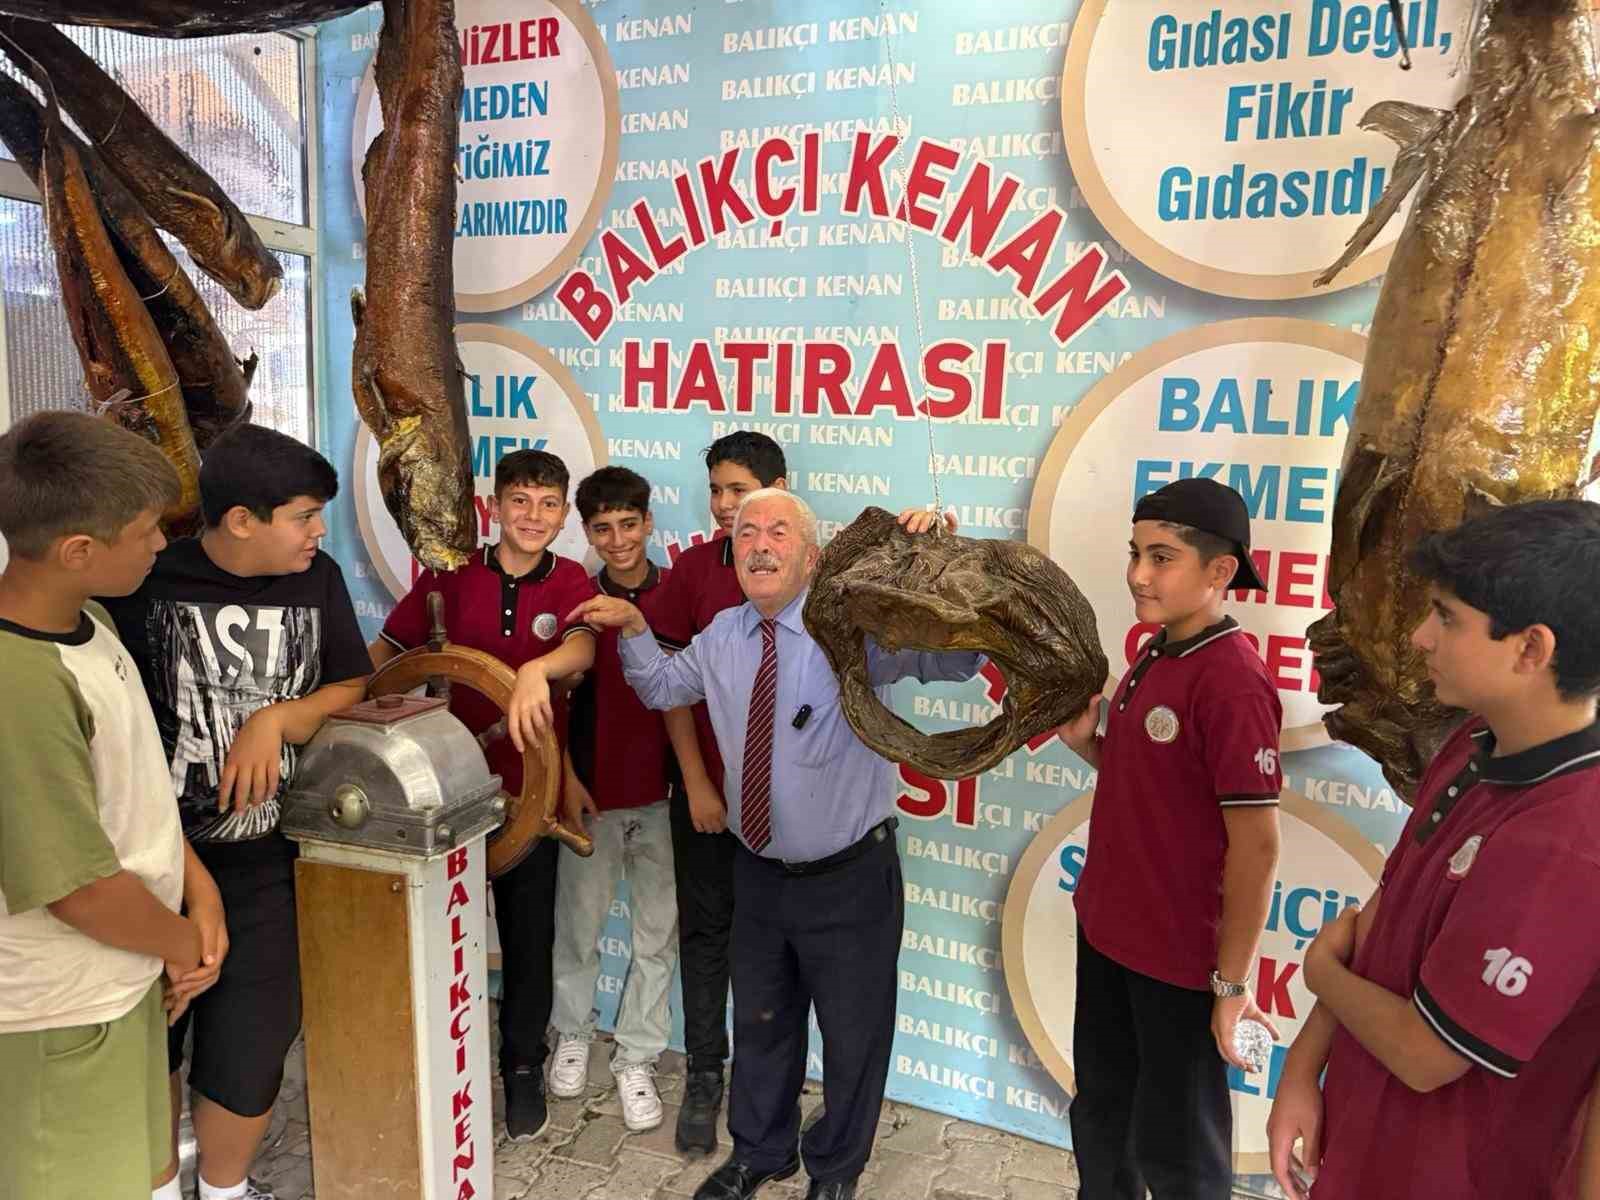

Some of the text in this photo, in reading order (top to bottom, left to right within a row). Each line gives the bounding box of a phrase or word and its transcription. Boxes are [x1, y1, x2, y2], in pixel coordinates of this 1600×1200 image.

[616, 14, 691, 42] KENAN
[723, 11, 918, 52] BALIKÇI KENAN
[955, 23, 1069, 55] BALIKÇI
[1148, 10, 1290, 71] Gıdası
[615, 64, 690, 89] KENAN
[722, 63, 915, 101] BALIKÇI KENAN
[1225, 79, 1353, 142] Fikir
[1158, 157, 1386, 221] Gıdasıdı
[454, 198, 568, 237] ARIMIZDIR
[555, 131, 1128, 343] BALIKÇI KENAN
[716, 273, 902, 302] BALIKÇI KENAN
[471, 374, 537, 419] LIK
[622, 340, 1008, 420] HATIRASI
[1159, 378, 1360, 436] BALIK
[608, 439, 680, 460] KENAN
[809, 424, 893, 447] KENAN
[808, 472, 890, 496] KENAN
[1254, 747, 1276, 775] 16
[907, 836, 1008, 879] BALIKÇI
[900, 970, 1000, 1016] BALIKÇI
[1481, 947, 1534, 996] 16
[897, 1013, 998, 1058] BALIKÇI
[896, 1054, 996, 1100] BALIKÇI
